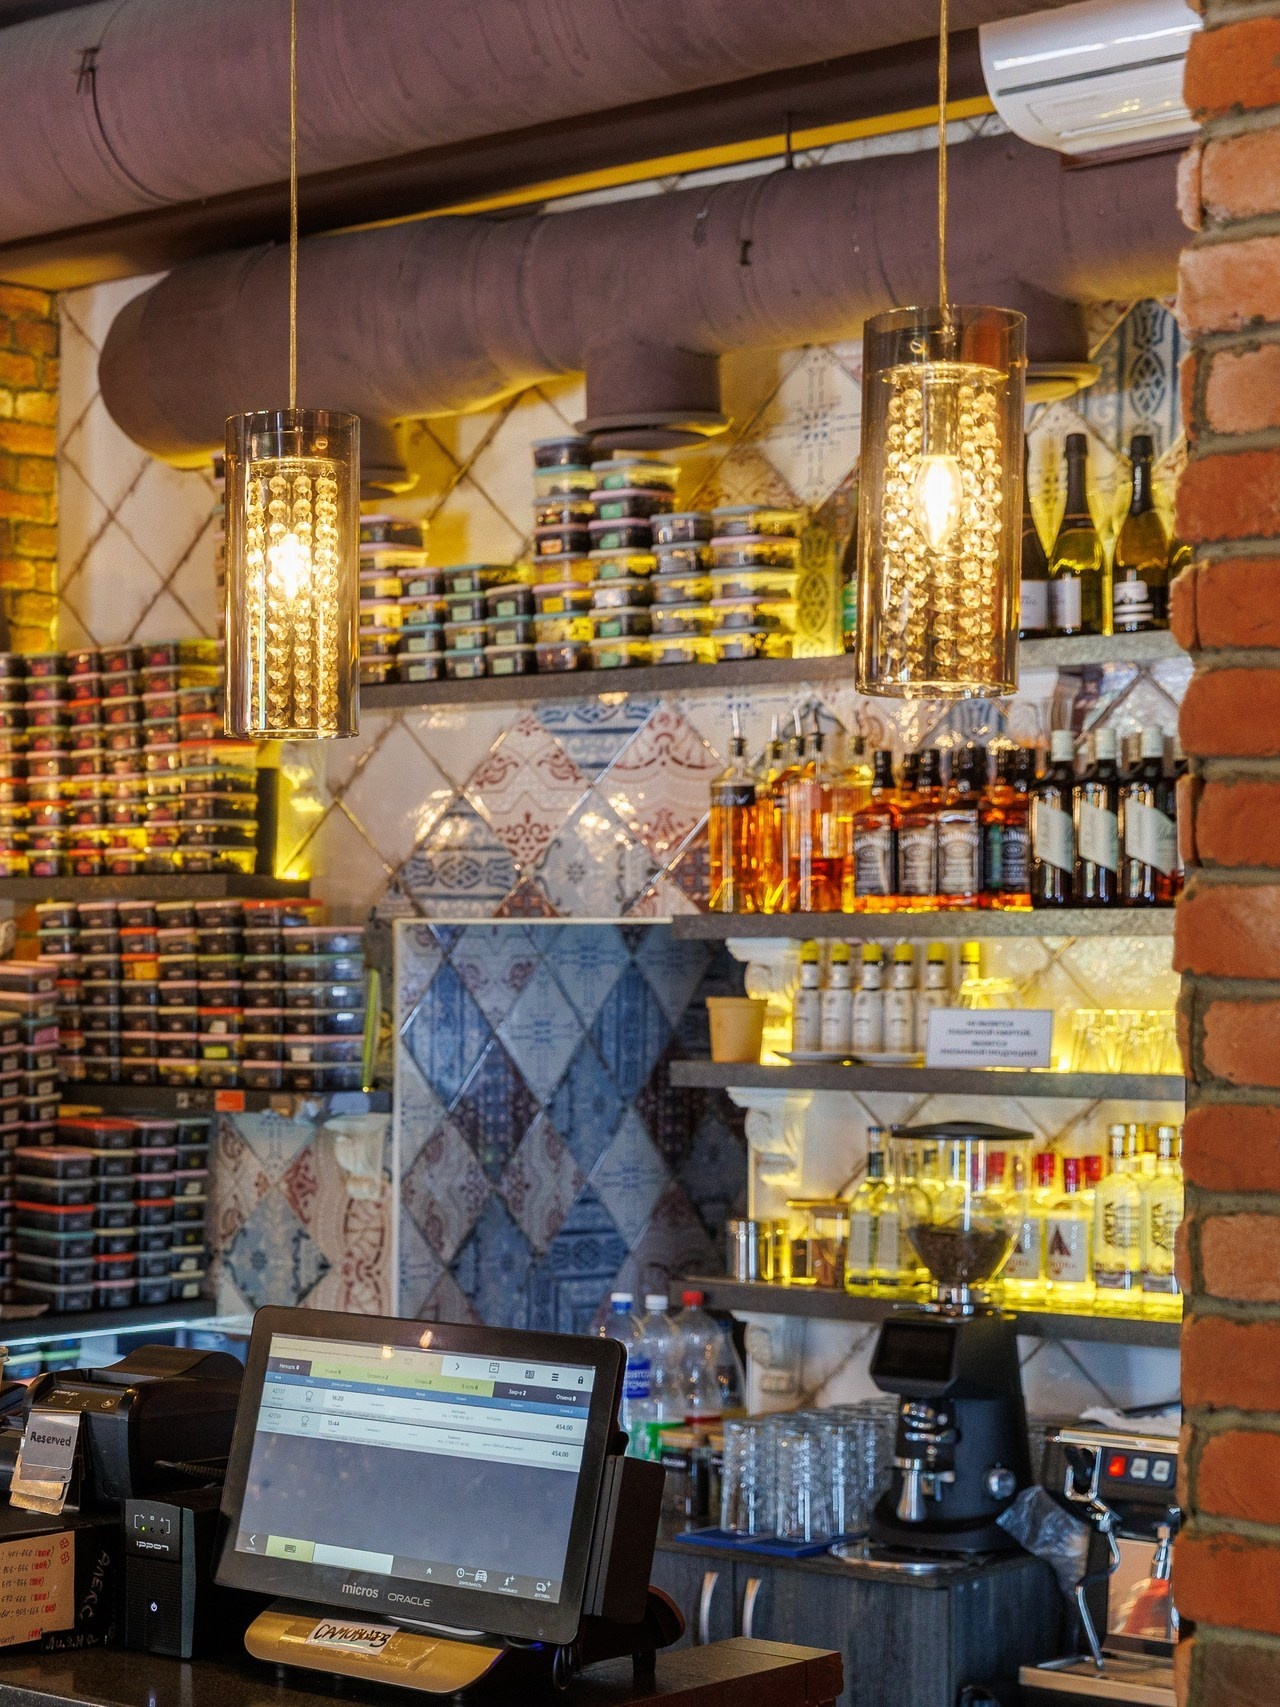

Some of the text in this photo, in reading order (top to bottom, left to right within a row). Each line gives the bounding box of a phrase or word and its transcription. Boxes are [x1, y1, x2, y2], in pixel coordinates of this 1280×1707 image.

[30, 1431, 72, 1447] Reserved
[341, 1582, 431, 1608] micros ORACLE
